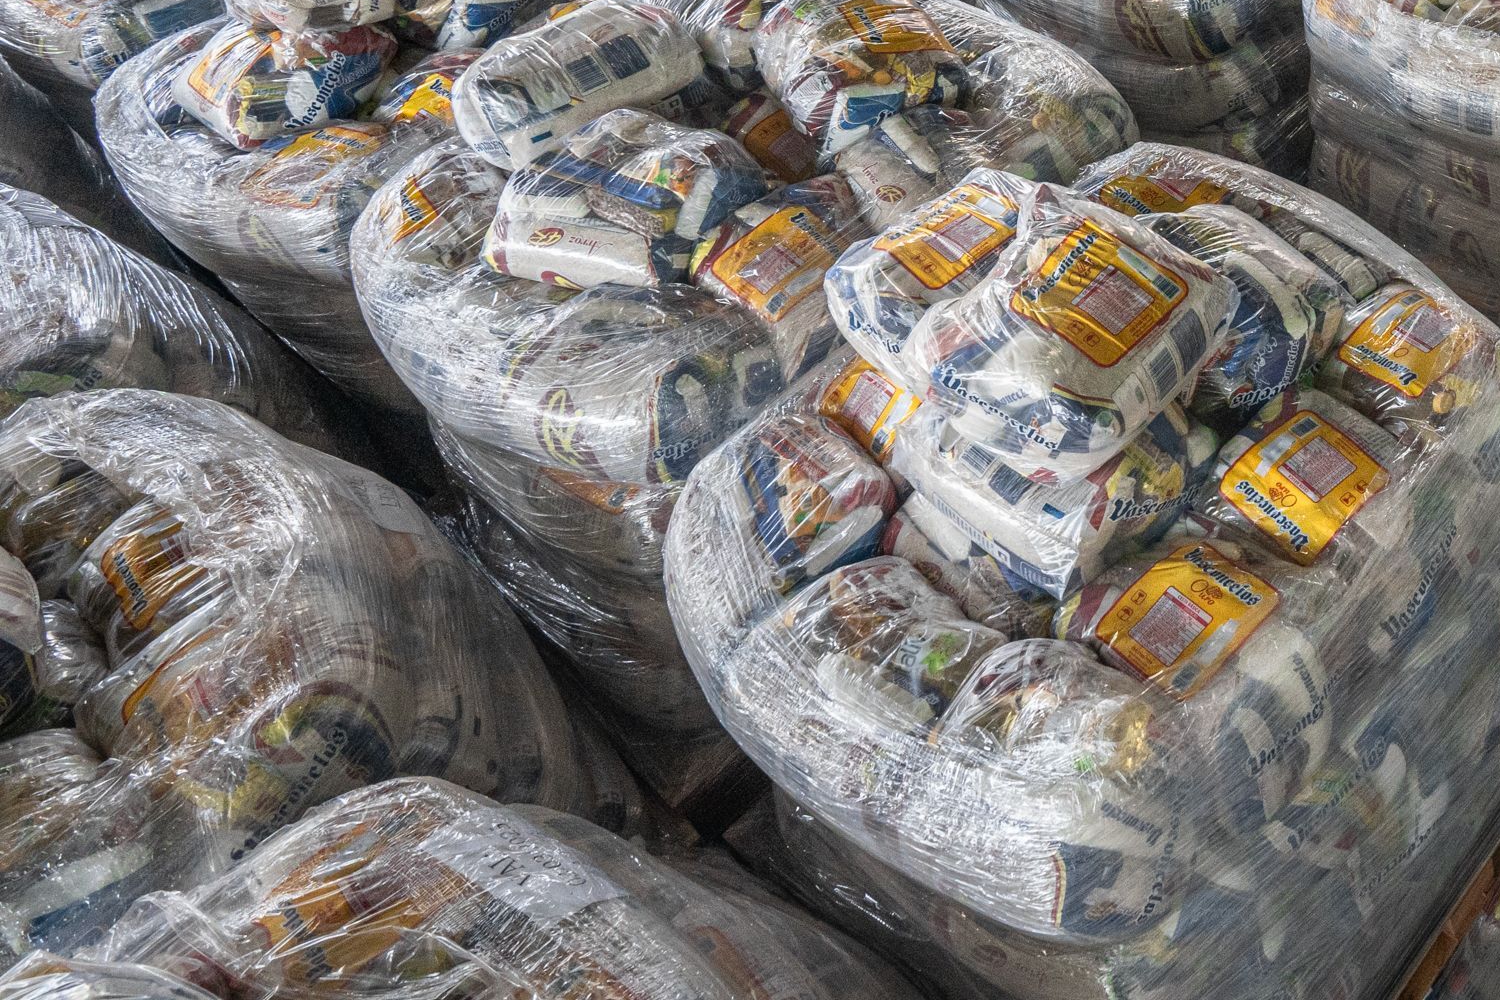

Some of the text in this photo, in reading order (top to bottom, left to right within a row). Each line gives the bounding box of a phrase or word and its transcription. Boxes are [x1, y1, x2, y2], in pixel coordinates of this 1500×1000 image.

[282, 49, 347, 130] Vasconcelos
[566, 232, 614, 255] Arroz
[1022, 231, 1099, 302] Vasconcelos
[1357, 343, 1417, 386] Vasconcelos
[940, 367, 1060, 451] Vasconcelos
[1235, 480, 1309, 552] Vasconcelos
[1183, 547, 1263, 607] Vasconcelos
